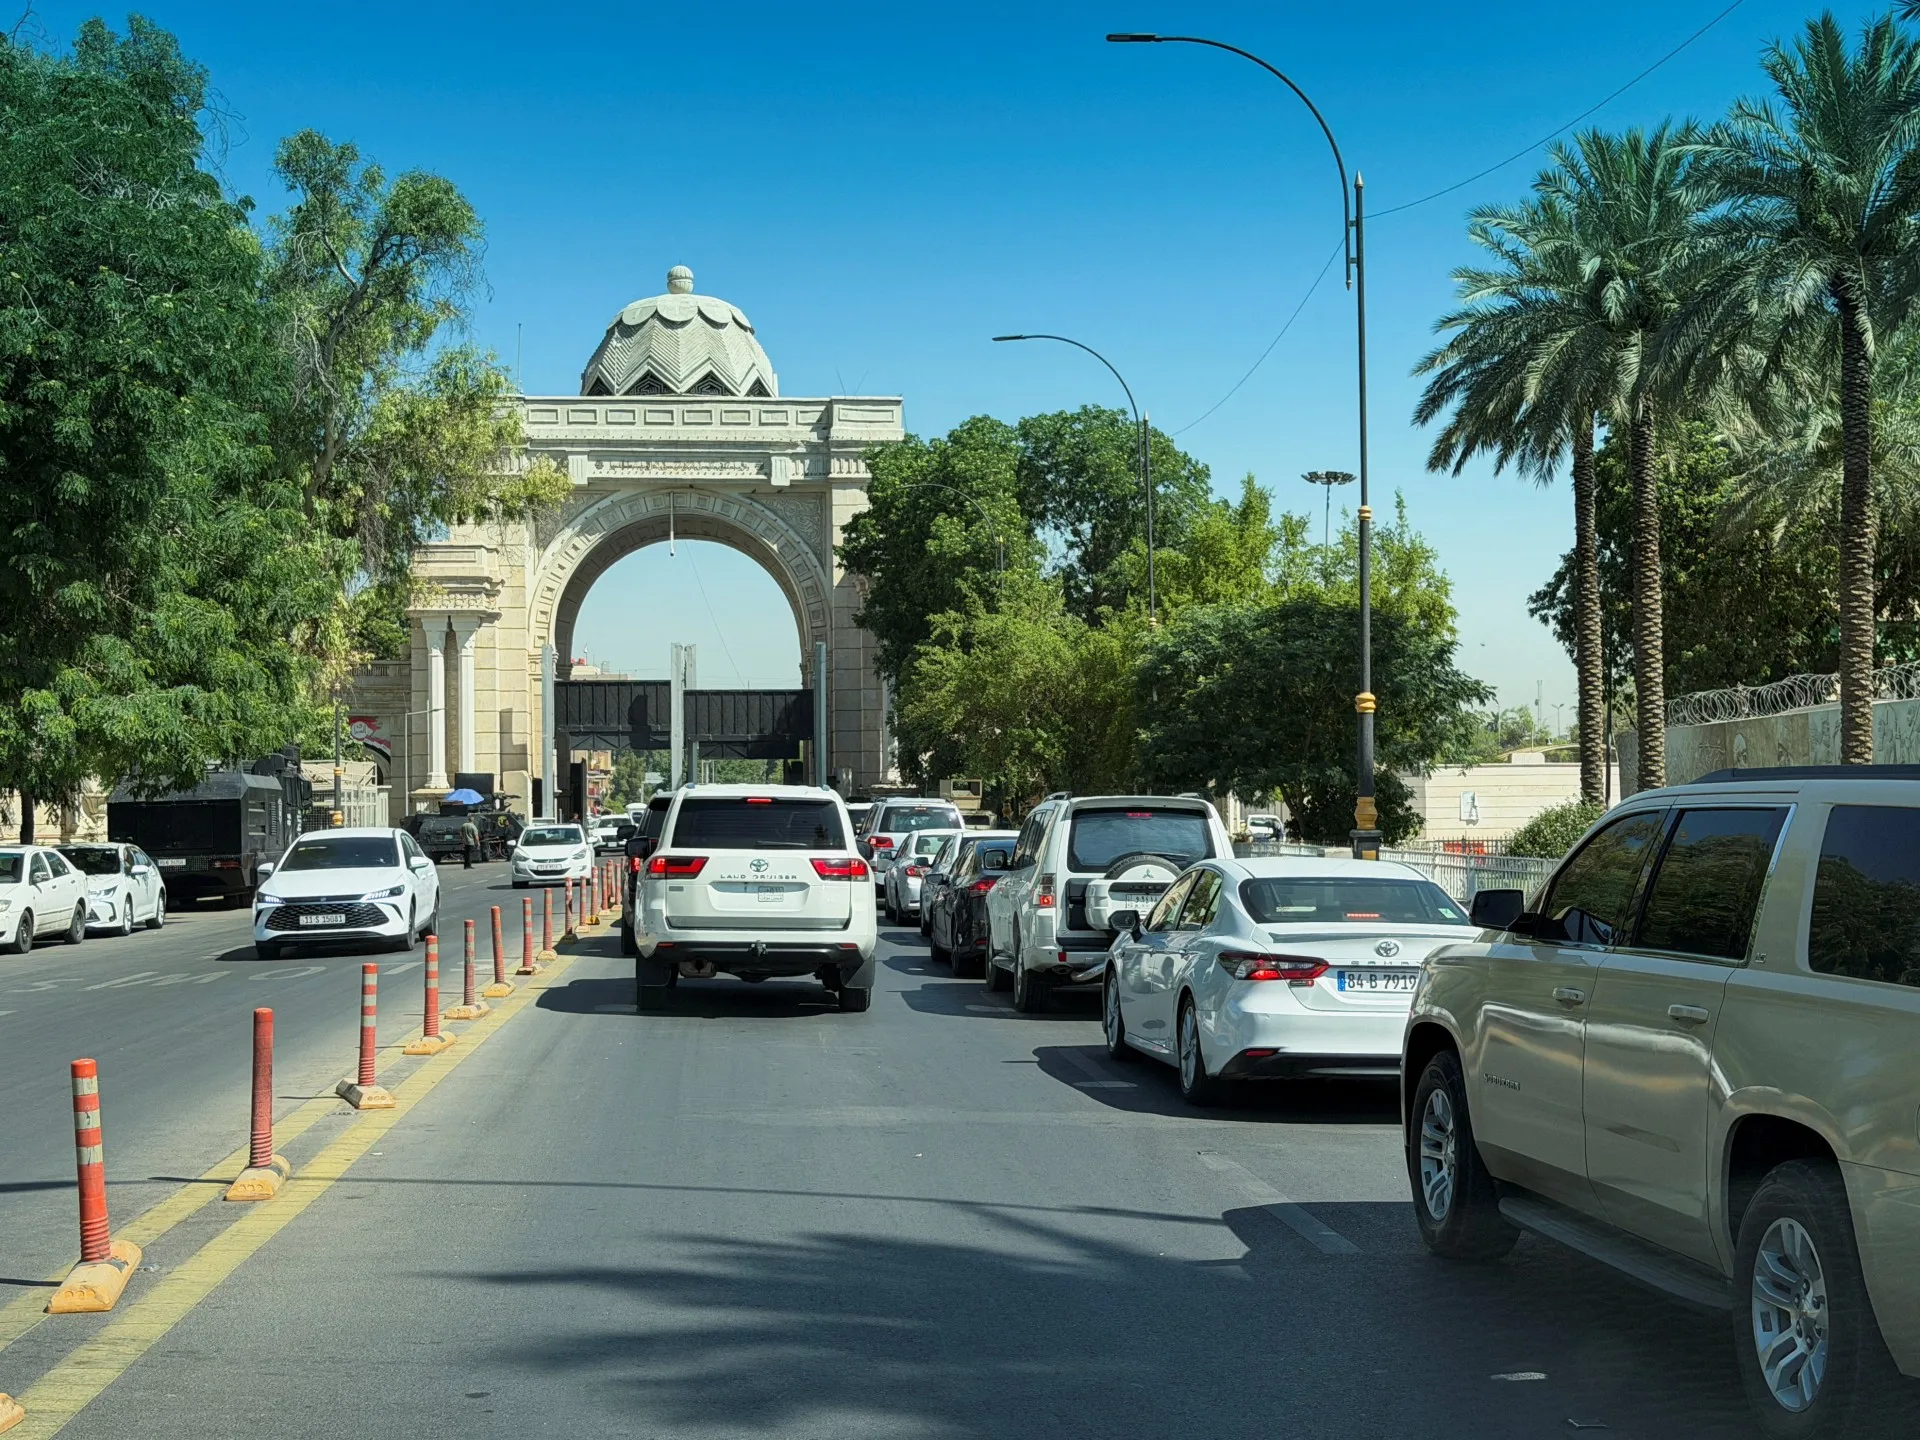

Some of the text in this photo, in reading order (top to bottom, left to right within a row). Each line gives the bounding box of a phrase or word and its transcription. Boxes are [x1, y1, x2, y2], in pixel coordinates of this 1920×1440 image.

[1347, 973, 1417, 990] 84 B 7919
